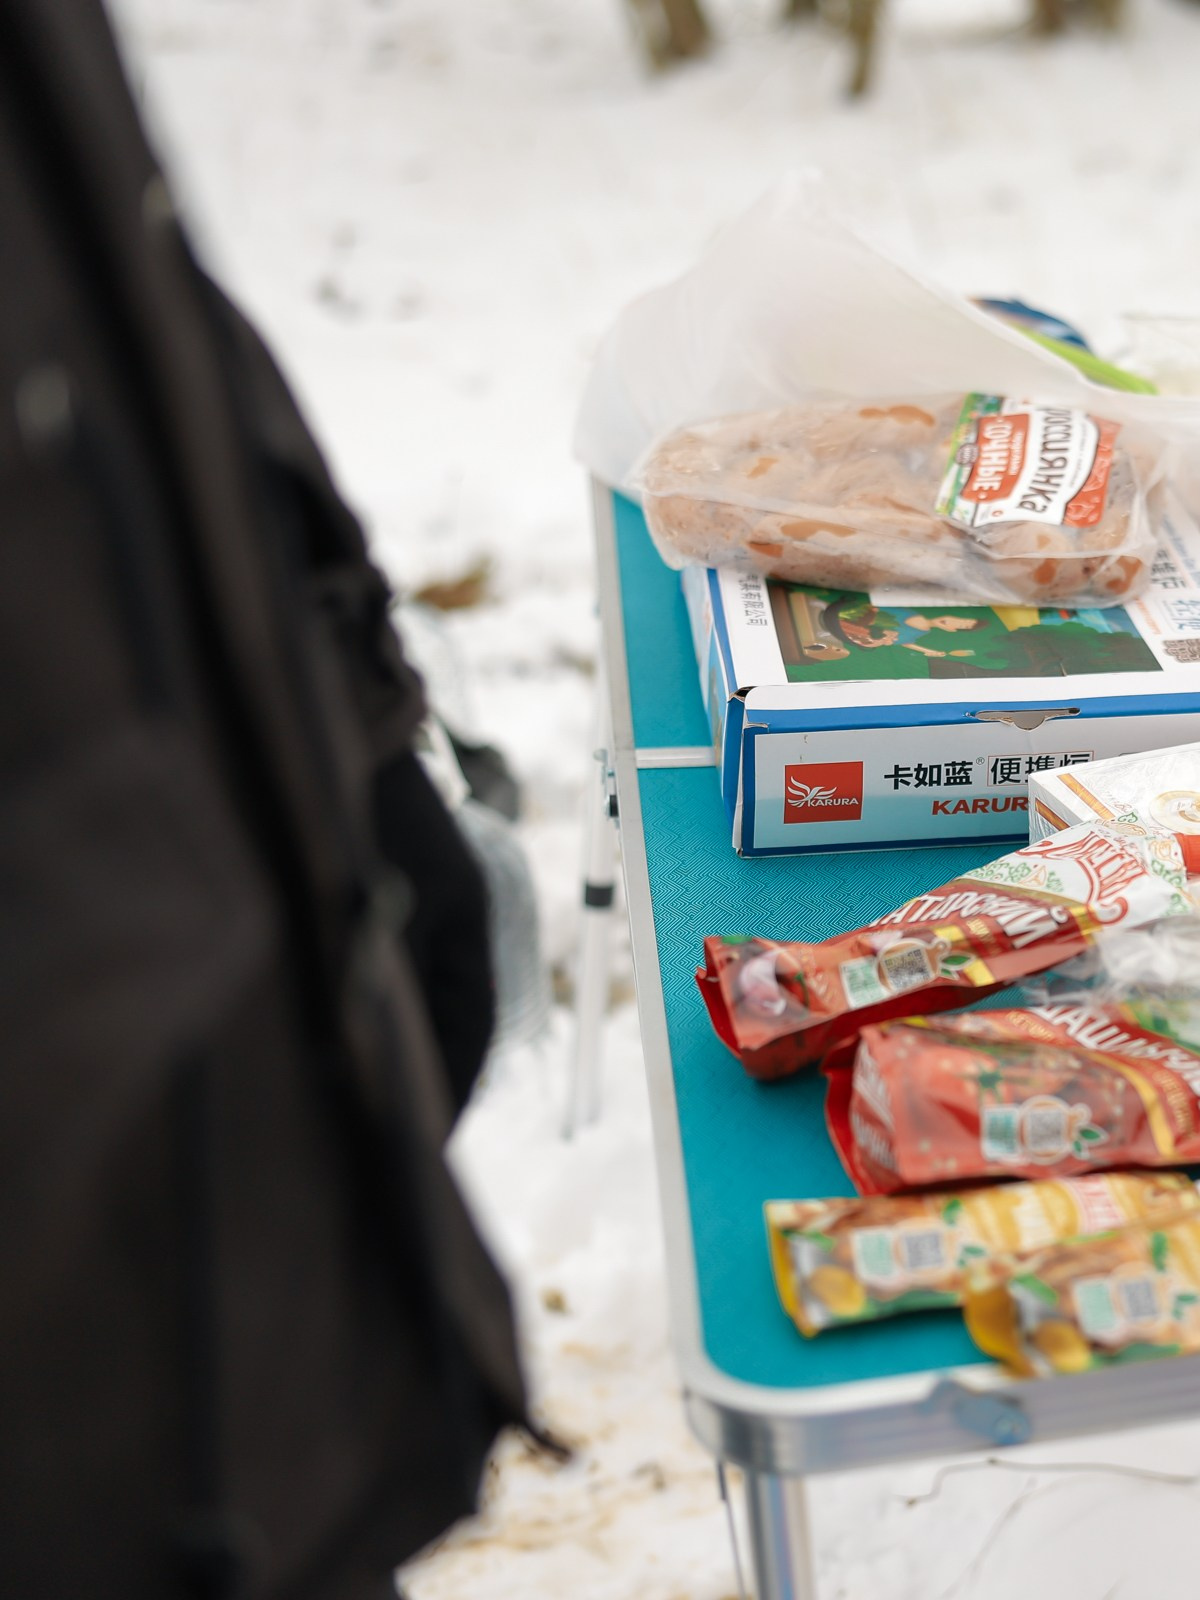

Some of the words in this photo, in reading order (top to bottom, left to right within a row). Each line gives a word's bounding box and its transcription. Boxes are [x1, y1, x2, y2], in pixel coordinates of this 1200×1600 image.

[972, 423, 1013, 492] СОЧНЫЕ
[806, 796, 859, 808] KARURA
[932, 797, 1028, 816] KARUR
